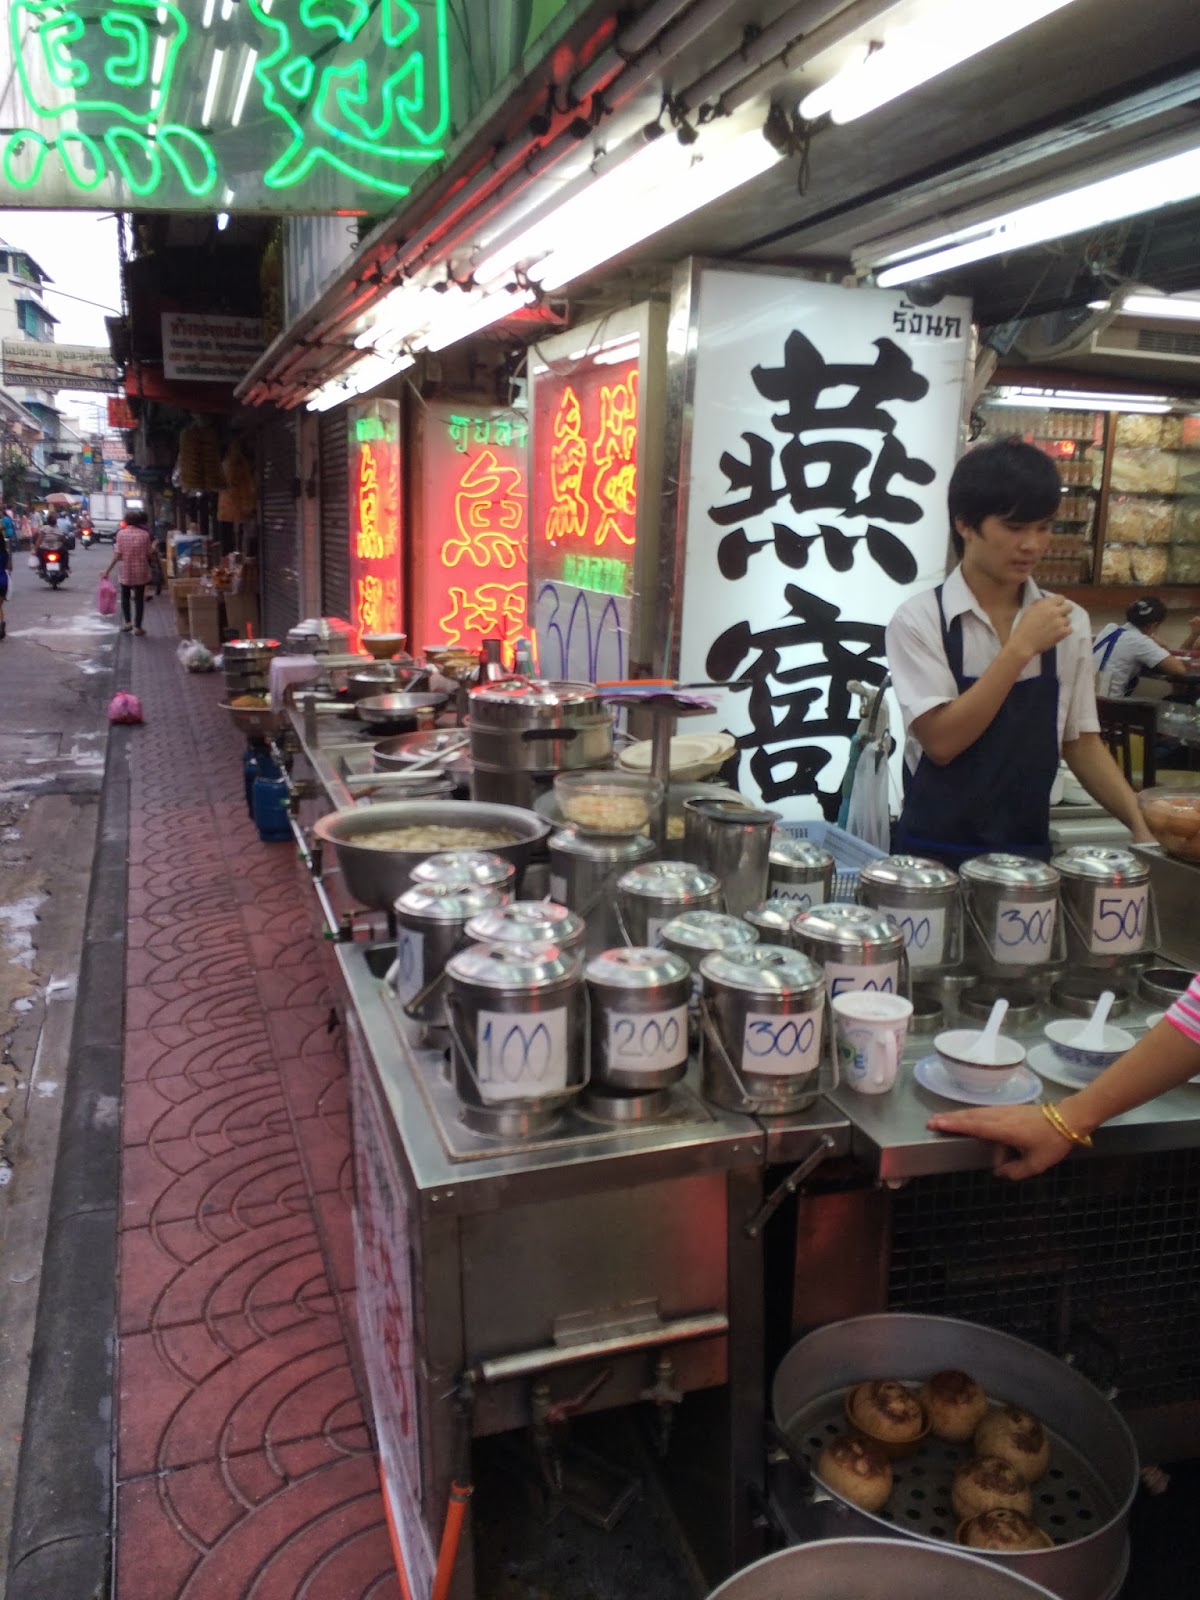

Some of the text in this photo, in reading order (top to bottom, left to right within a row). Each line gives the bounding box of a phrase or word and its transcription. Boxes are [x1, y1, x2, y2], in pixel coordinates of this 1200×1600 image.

[893, 300, 962, 338] รังนก
[886, 914, 930, 949] 00
[999, 909, 1051, 947] 300
[1094, 896, 1147, 943] 500
[482, 1021, 551, 1082] 100
[614, 1017, 680, 1056] 200
[744, 1018, 815, 1057] 300
